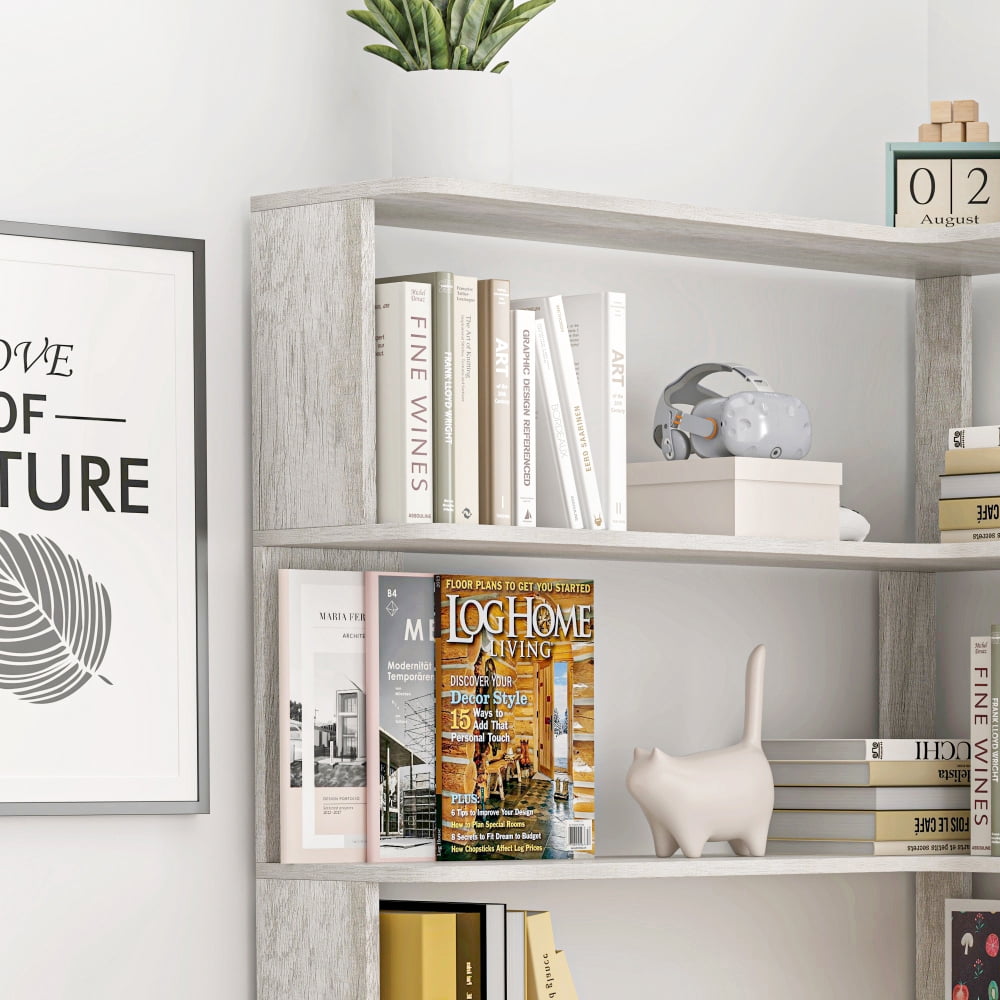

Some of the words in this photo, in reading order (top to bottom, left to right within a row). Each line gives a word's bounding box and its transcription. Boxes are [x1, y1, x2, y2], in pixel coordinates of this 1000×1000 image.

[920, 212, 980, 227] August
[410, 316, 427, 380] FINE
[495, 337, 509, 378] ART
[522, 329, 532, 375] GRAPHIC
[611, 348, 625, 388] ART
[522, 379, 532, 416] DESIGN
[410, 395, 428, 492] WINES
[522, 419, 532, 487] REFERENCED
[446, 579, 473, 590] FLOOR
[475, 580, 503, 591] PLANS
[505, 581, 515, 591] TO
[518, 581, 534, 592] GET
[536, 582, 552, 592] YOU
[555, 583, 591, 593] STARTED
[319, 612, 347, 622] MARIA
[490, 640, 553, 659] LIVING
[450, 675, 490, 687] DISCOVER
[491, 675, 512, 687] YOUR
[450, 690, 490, 705] Decor
[493, 690, 528, 709] Style
[974, 667, 988, 725] FINE
[450, 708, 471, 730] 15
[472, 709, 493, 720] Ways
[495, 709, 504, 718] to
[991, 697, 999, 722] FRANK
[473, 720, 488, 730] Add
[491, 720, 509, 730] That
[991, 723, 999, 749] LLOYD
[451, 732, 485, 743] Personal
[488, 732, 511, 743] Touch
[991, 750, 999, 782] WRIGHT
[974, 738, 989, 826] WINES
[451, 793, 480, 804] PLUS:
[914, 817, 936, 836] CAFÉ
[938, 817, 949, 833] LE
[951, 817, 970, 833] FOIS
